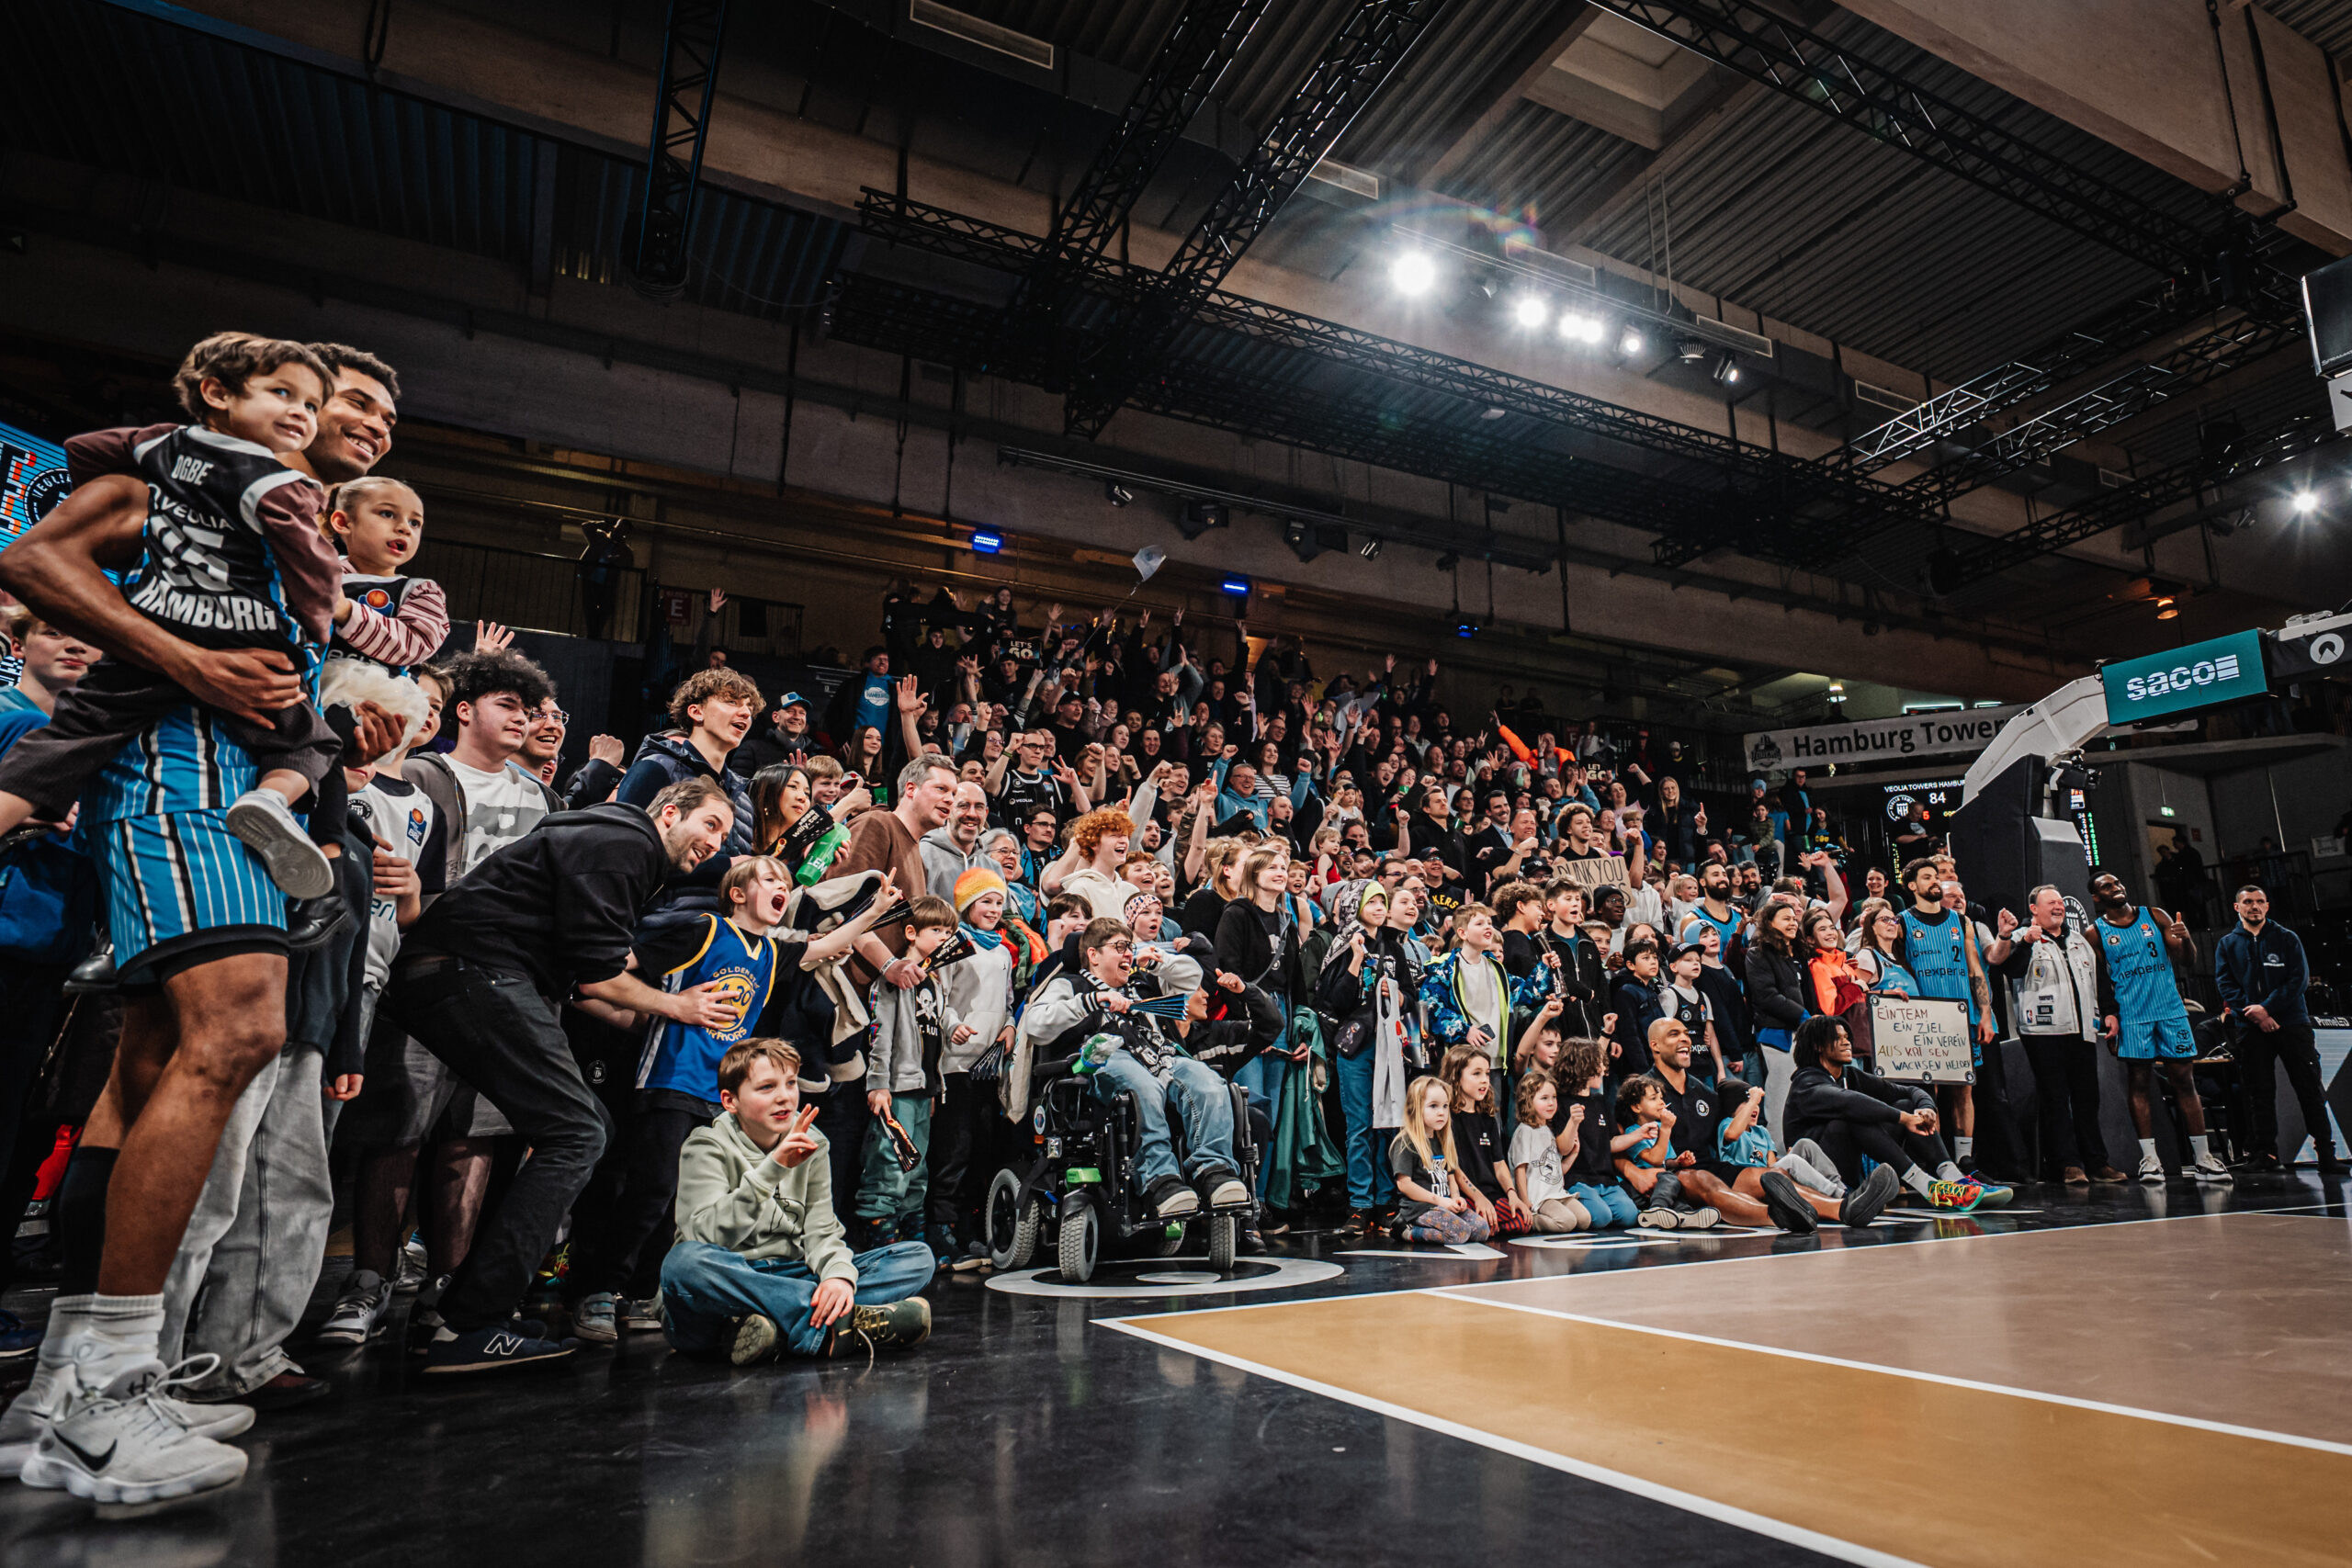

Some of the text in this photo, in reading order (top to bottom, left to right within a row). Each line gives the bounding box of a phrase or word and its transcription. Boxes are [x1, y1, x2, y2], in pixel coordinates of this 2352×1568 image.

[171, 454, 214, 486] OGBE
[161, 495, 235, 531] VEOLIA
[130, 575, 277, 631] HAMBURG
[671, 598, 684, 617] E
[1011, 640, 1033, 649] LET'S
[1008, 647, 1034, 659] GO
[1793, 718, 2012, 757] Hamburg Tower
[1884, 784, 1908, 793] VEOLIA
[1908, 782, 1938, 790] TOWERS
[1929, 792, 1946, 804] 84
[1594, 858, 1623, 883] YOU
[1432, 895, 1459, 908] KERS
[2147, 941, 2158, 958] 3
[713, 966, 750, 977] GOLDEN
[1917, 967, 1966, 977] nexperia
[2119, 962, 2165, 981] nexperia
[731, 985, 752, 1006] 30
[1896, 1008, 1928, 1021] TEAM
[1916, 1022, 1948, 1033] ZIEL
[705, 1026, 748, 1043] ARRIORS
[1877, 1044, 1903, 1057] AUS
[1892, 1059, 1971, 1071] WACHSEN HELDEN
